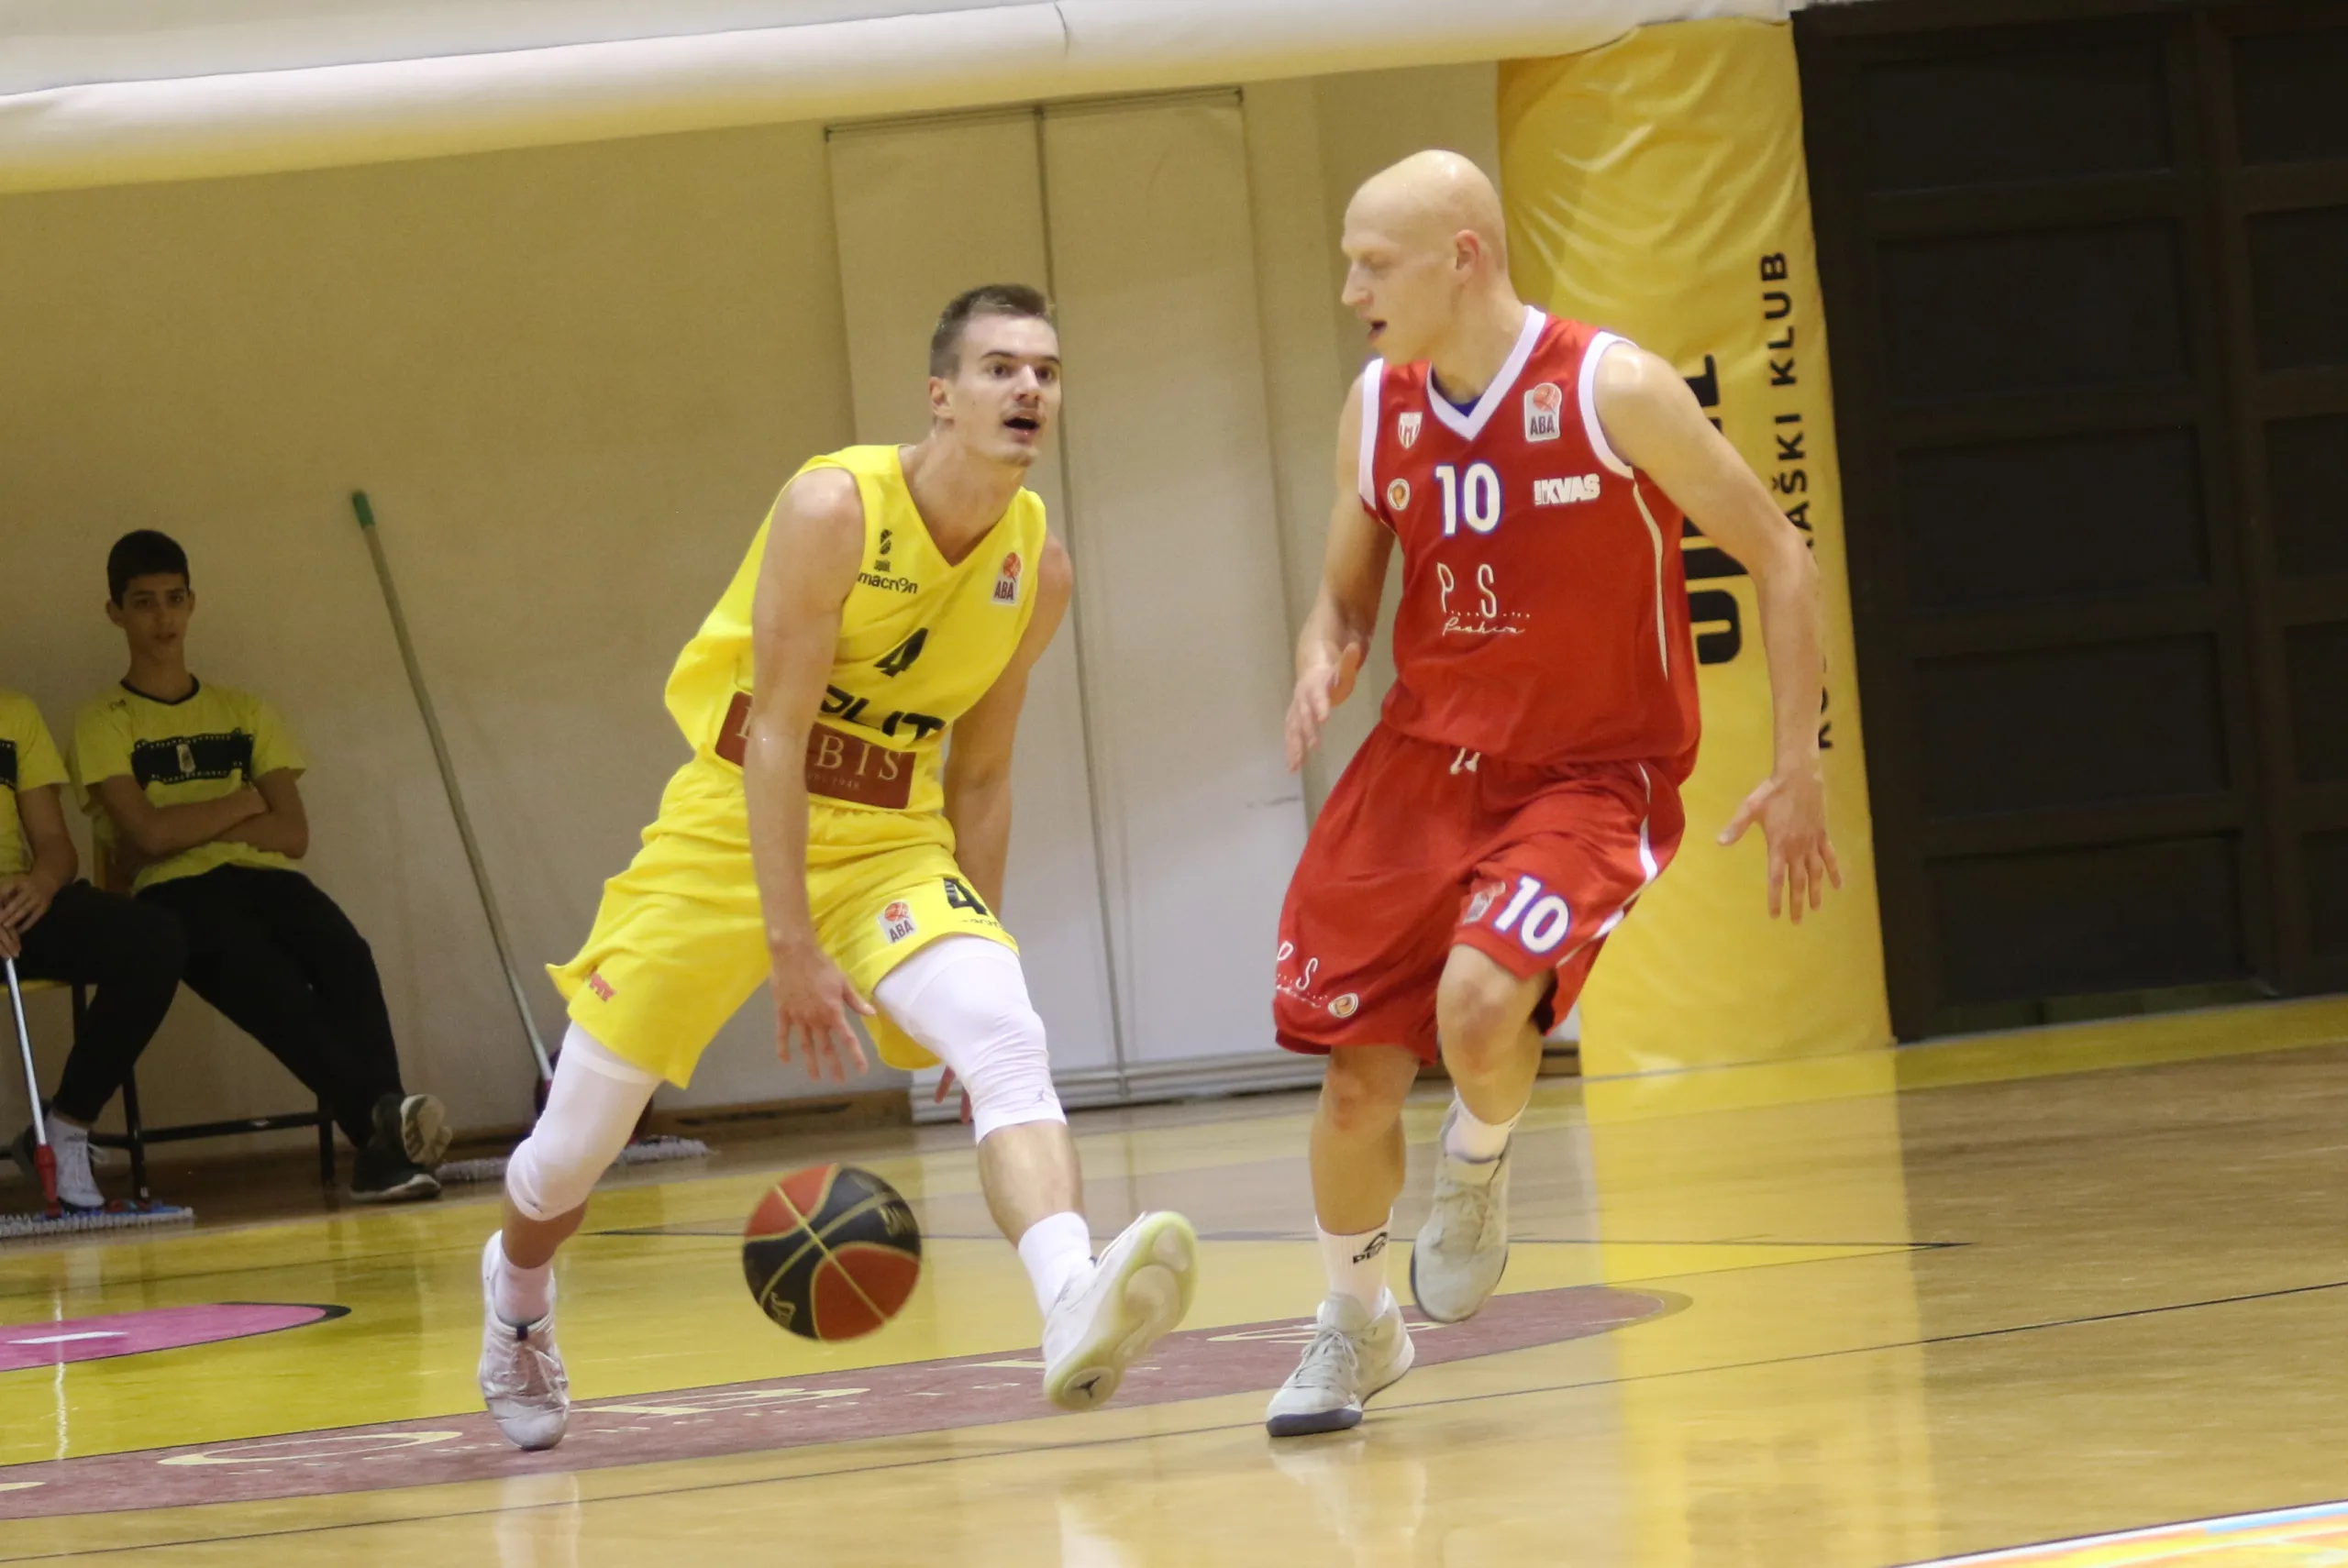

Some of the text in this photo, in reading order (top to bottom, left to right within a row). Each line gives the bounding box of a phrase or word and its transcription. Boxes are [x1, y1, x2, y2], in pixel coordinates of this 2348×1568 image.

[1761, 252, 1797, 386] KLUB
[1530, 415, 1555, 436] ABA
[1434, 460, 1504, 536] 10
[858, 572, 919, 594] macron
[993, 580, 1014, 601] ABA
[873, 627, 929, 678] 4
[943, 878, 988, 916] 4
[1491, 873, 1571, 955] 10
[889, 920, 914, 943] ABA
